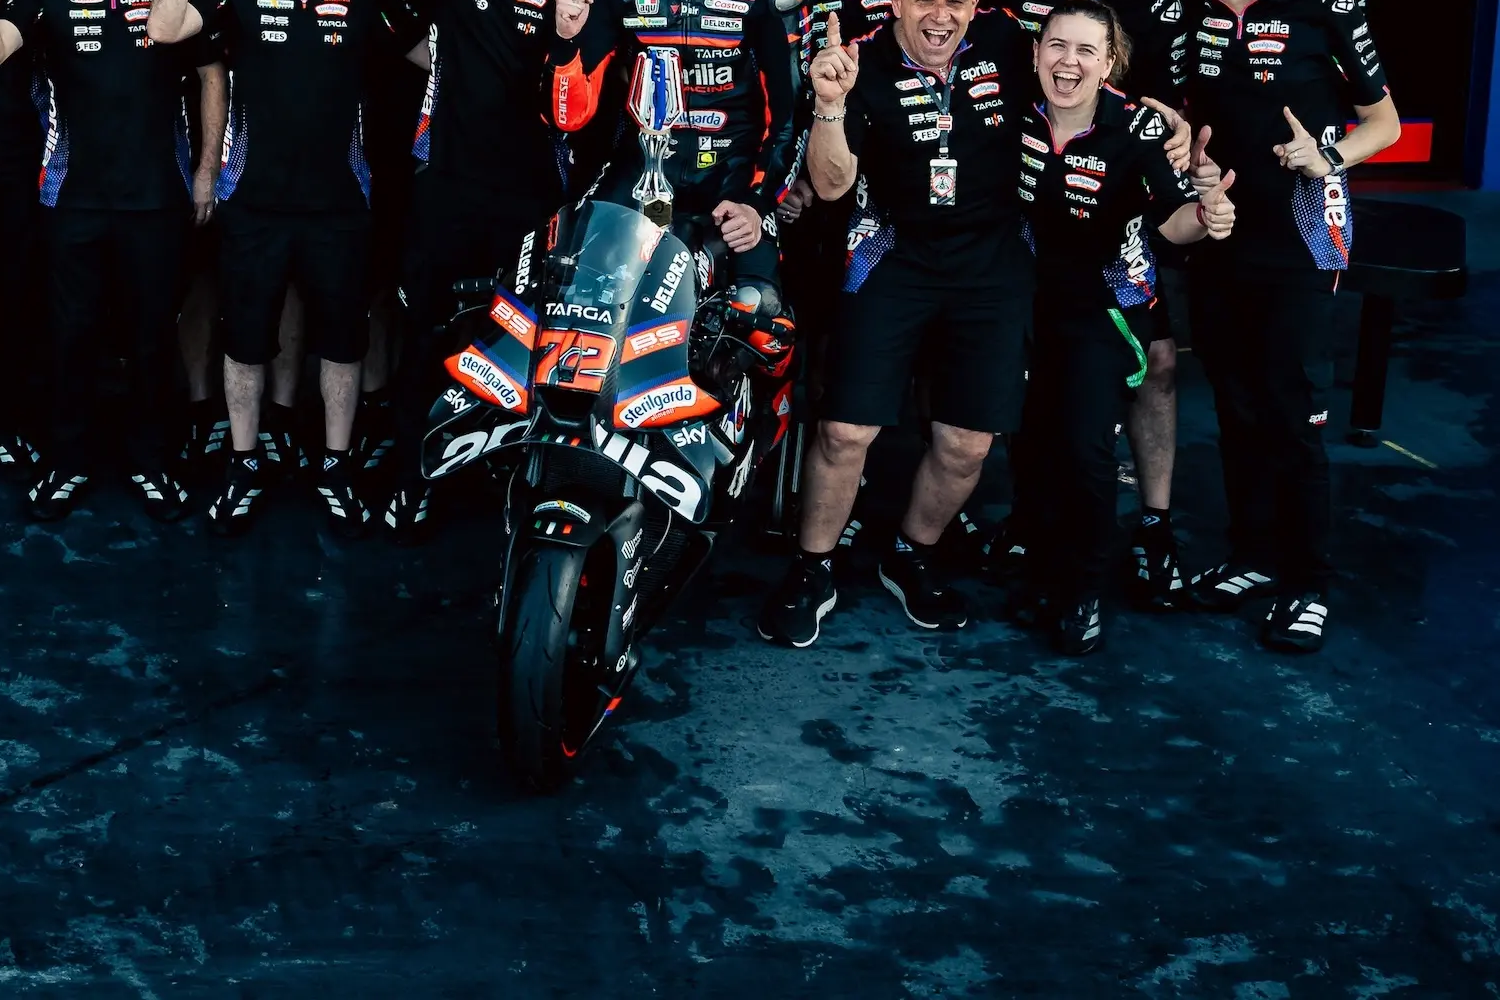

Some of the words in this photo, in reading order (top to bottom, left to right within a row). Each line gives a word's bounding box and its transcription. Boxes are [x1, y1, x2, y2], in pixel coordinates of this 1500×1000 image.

[513, 5, 544, 20] TARGA
[714, 0, 748, 12] Castrol
[825, 1, 841, 10] Power
[260, 14, 290, 24] BS
[317, 19, 348, 28] TARGA
[703, 19, 740, 29] DELLORTO
[73, 25, 102, 34] BS
[1245, 20, 1290, 36] aprilia
[269, 33, 285, 41] FES
[83, 42, 99, 50] FES
[695, 48, 742, 58] TARGA
[1200, 46, 1222, 57] BS
[1249, 41, 1282, 51] sterilgarda
[1248, 57, 1283, 66] TARGA
[683, 62, 734, 86] rilia
[960, 60, 998, 82] aprilia
[1204, 65, 1219, 75] FES
[683, 84, 735, 93] ACING
[558, 75, 570, 126] DAINESE
[972, 98, 1004, 111] TARGA
[908, 111, 940, 123] BS
[1128, 105, 1148, 134] IXON
[921, 130, 938, 140] FES
[1023, 135, 1048, 152] Castrol
[1064, 153, 1107, 173] aprilia
[1067, 176, 1098, 189] sterilgarda
[1064, 190, 1098, 206] TARGA
[515, 230, 536, 295] DELLORTO
[650, 250, 691, 314] DELLORTO
[492, 301, 531, 336] BS
[545, 302, 613, 325] TARGA
[629, 325, 681, 350] BS
[535, 327, 617, 393] 72
[461, 355, 516, 405] sterilgarda
[443, 387, 472, 414] sky
[624, 385, 693, 423] sterilgarda
[672, 423, 707, 448] sky
